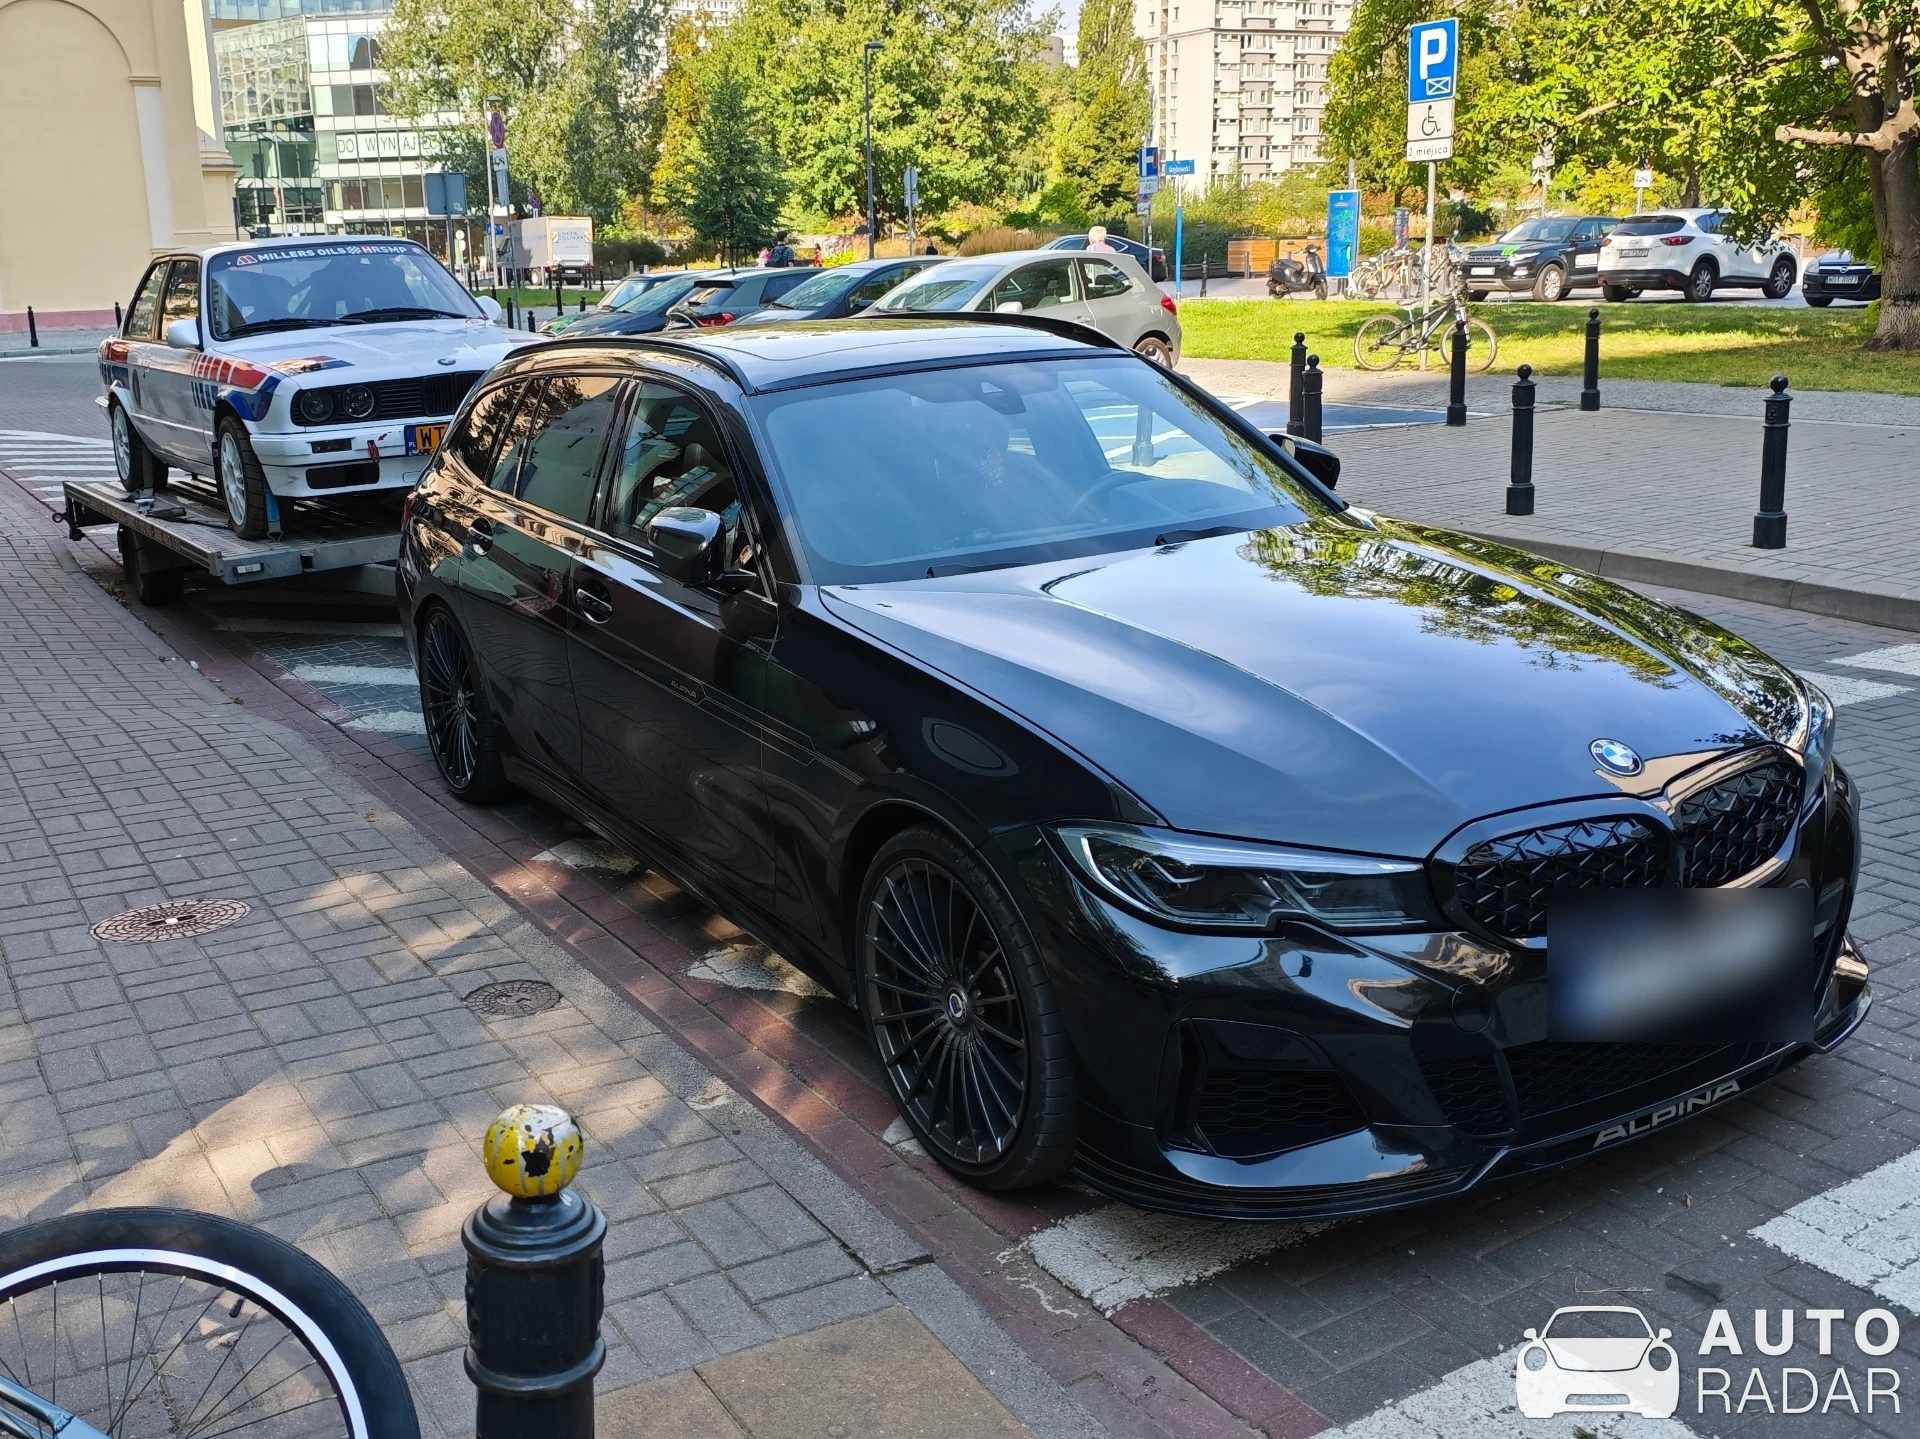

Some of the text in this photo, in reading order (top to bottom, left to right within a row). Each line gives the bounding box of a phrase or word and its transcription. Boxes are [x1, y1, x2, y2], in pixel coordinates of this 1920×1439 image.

[1420, 28, 1448, 80] P
[338, 134, 439, 153] DO WYNAJĘC
[1408, 145, 1448, 157] 2 miejsca
[257, 245, 407, 262] MILLERS OILS HRSMP
[420, 426, 446, 448] WT
[670, 680, 697, 699] ALPINA
[1592, 1079, 1741, 1148] ALPINA
